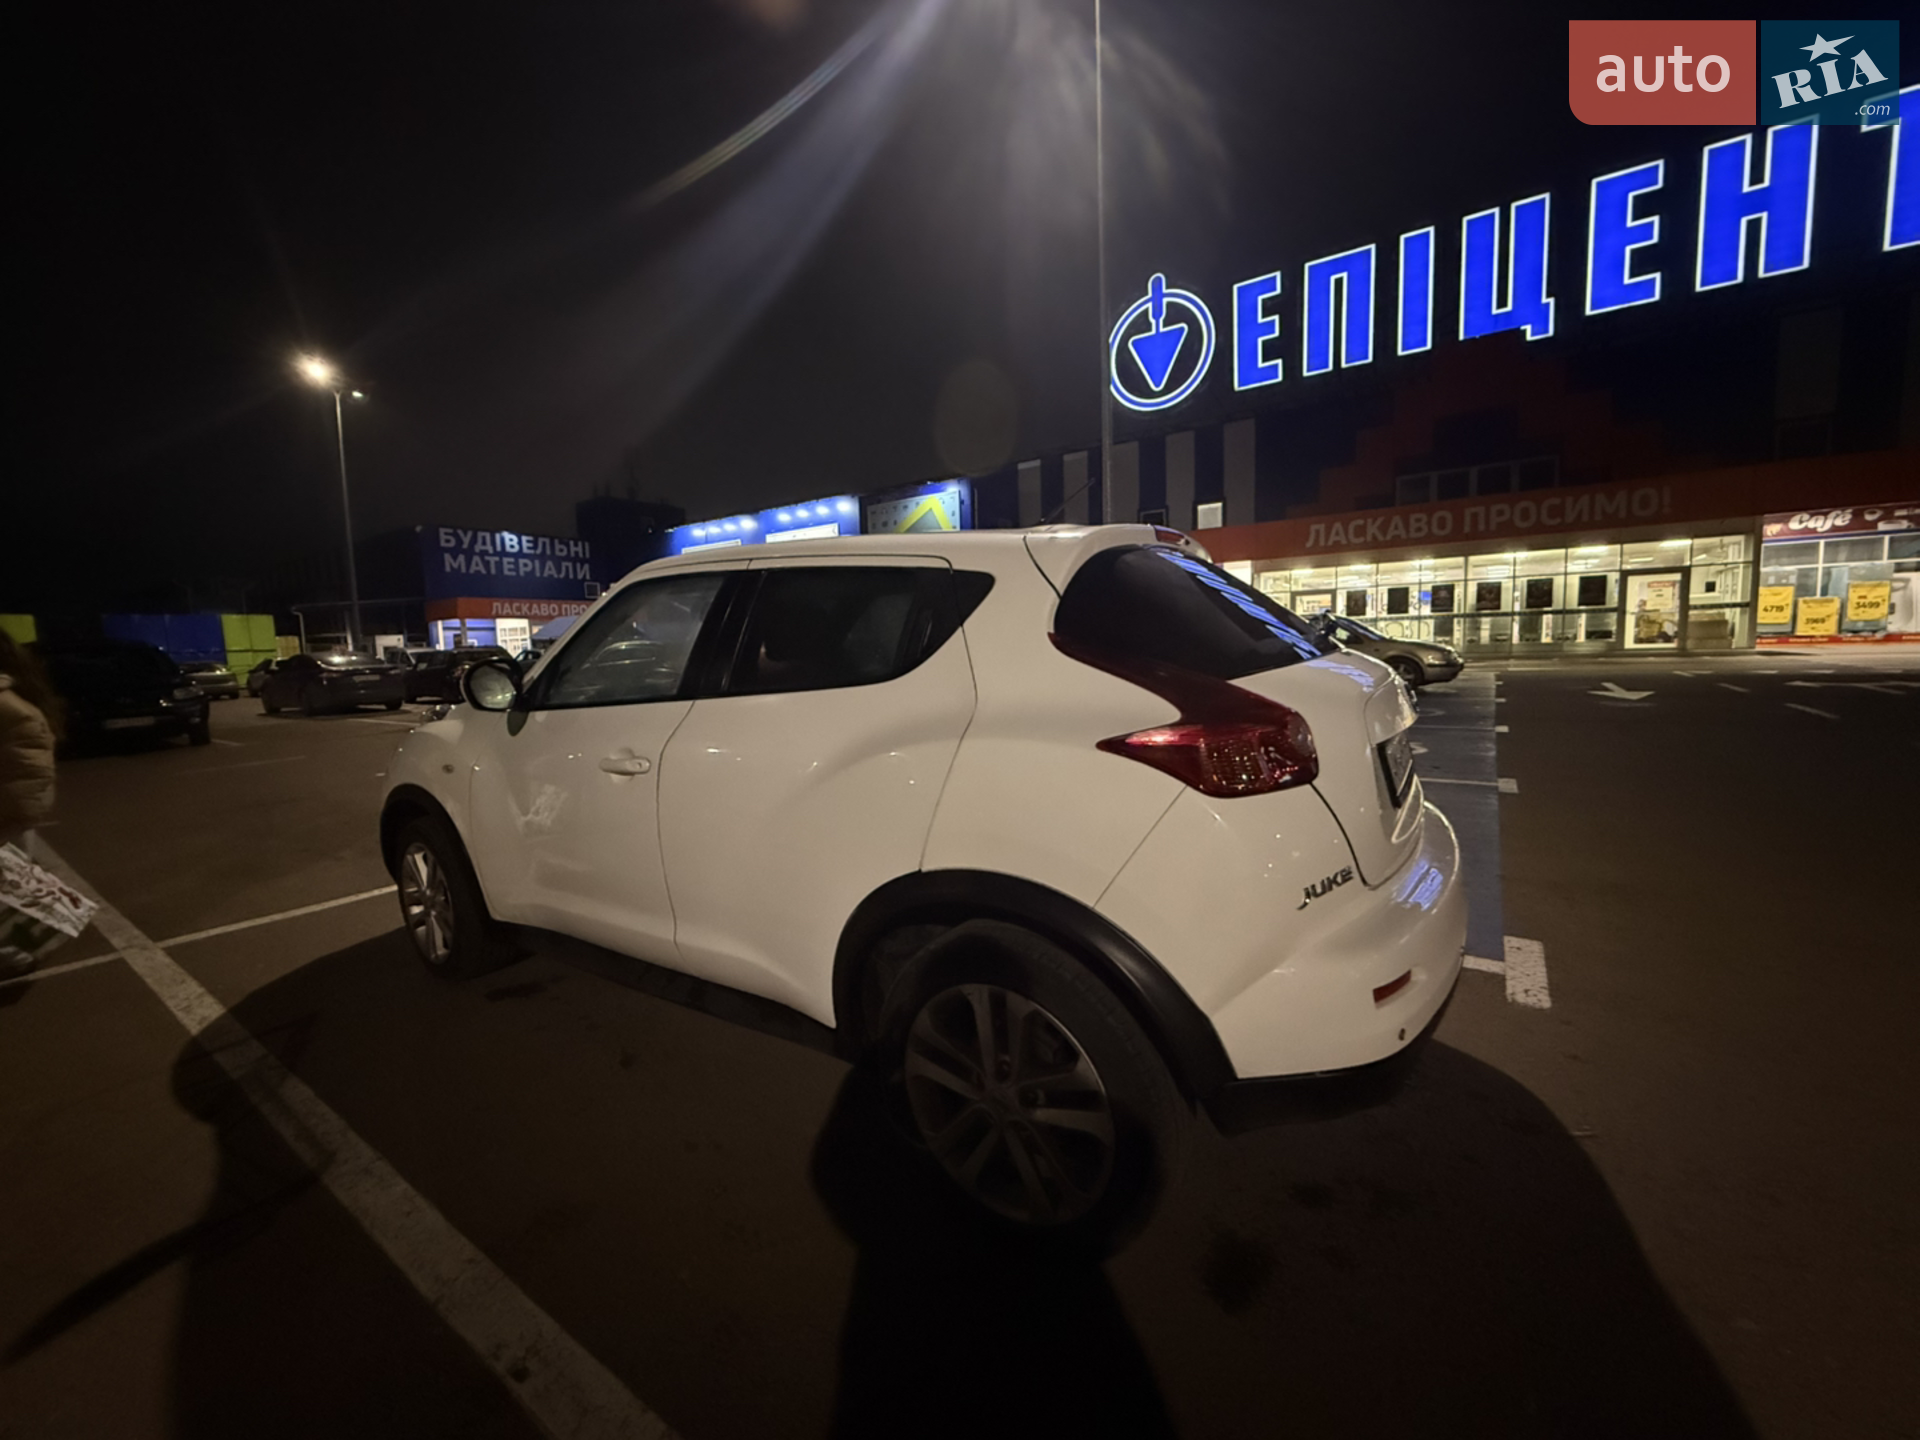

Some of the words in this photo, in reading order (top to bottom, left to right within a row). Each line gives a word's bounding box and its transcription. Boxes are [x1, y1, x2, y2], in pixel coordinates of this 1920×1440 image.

[1305, 510, 1454, 548] ЛАСКАВО
[1463, 486, 1672, 534] ПРОСИМО!
[1788, 508, 1853, 533] Café
[438, 527, 590, 559] БУДІВЕЛЬНІ
[444, 553, 591, 580] МАТЕРІАЛИ
[491, 602, 559, 616] ЛАСКАВО
[1296, 865, 1354, 911] JUKE
